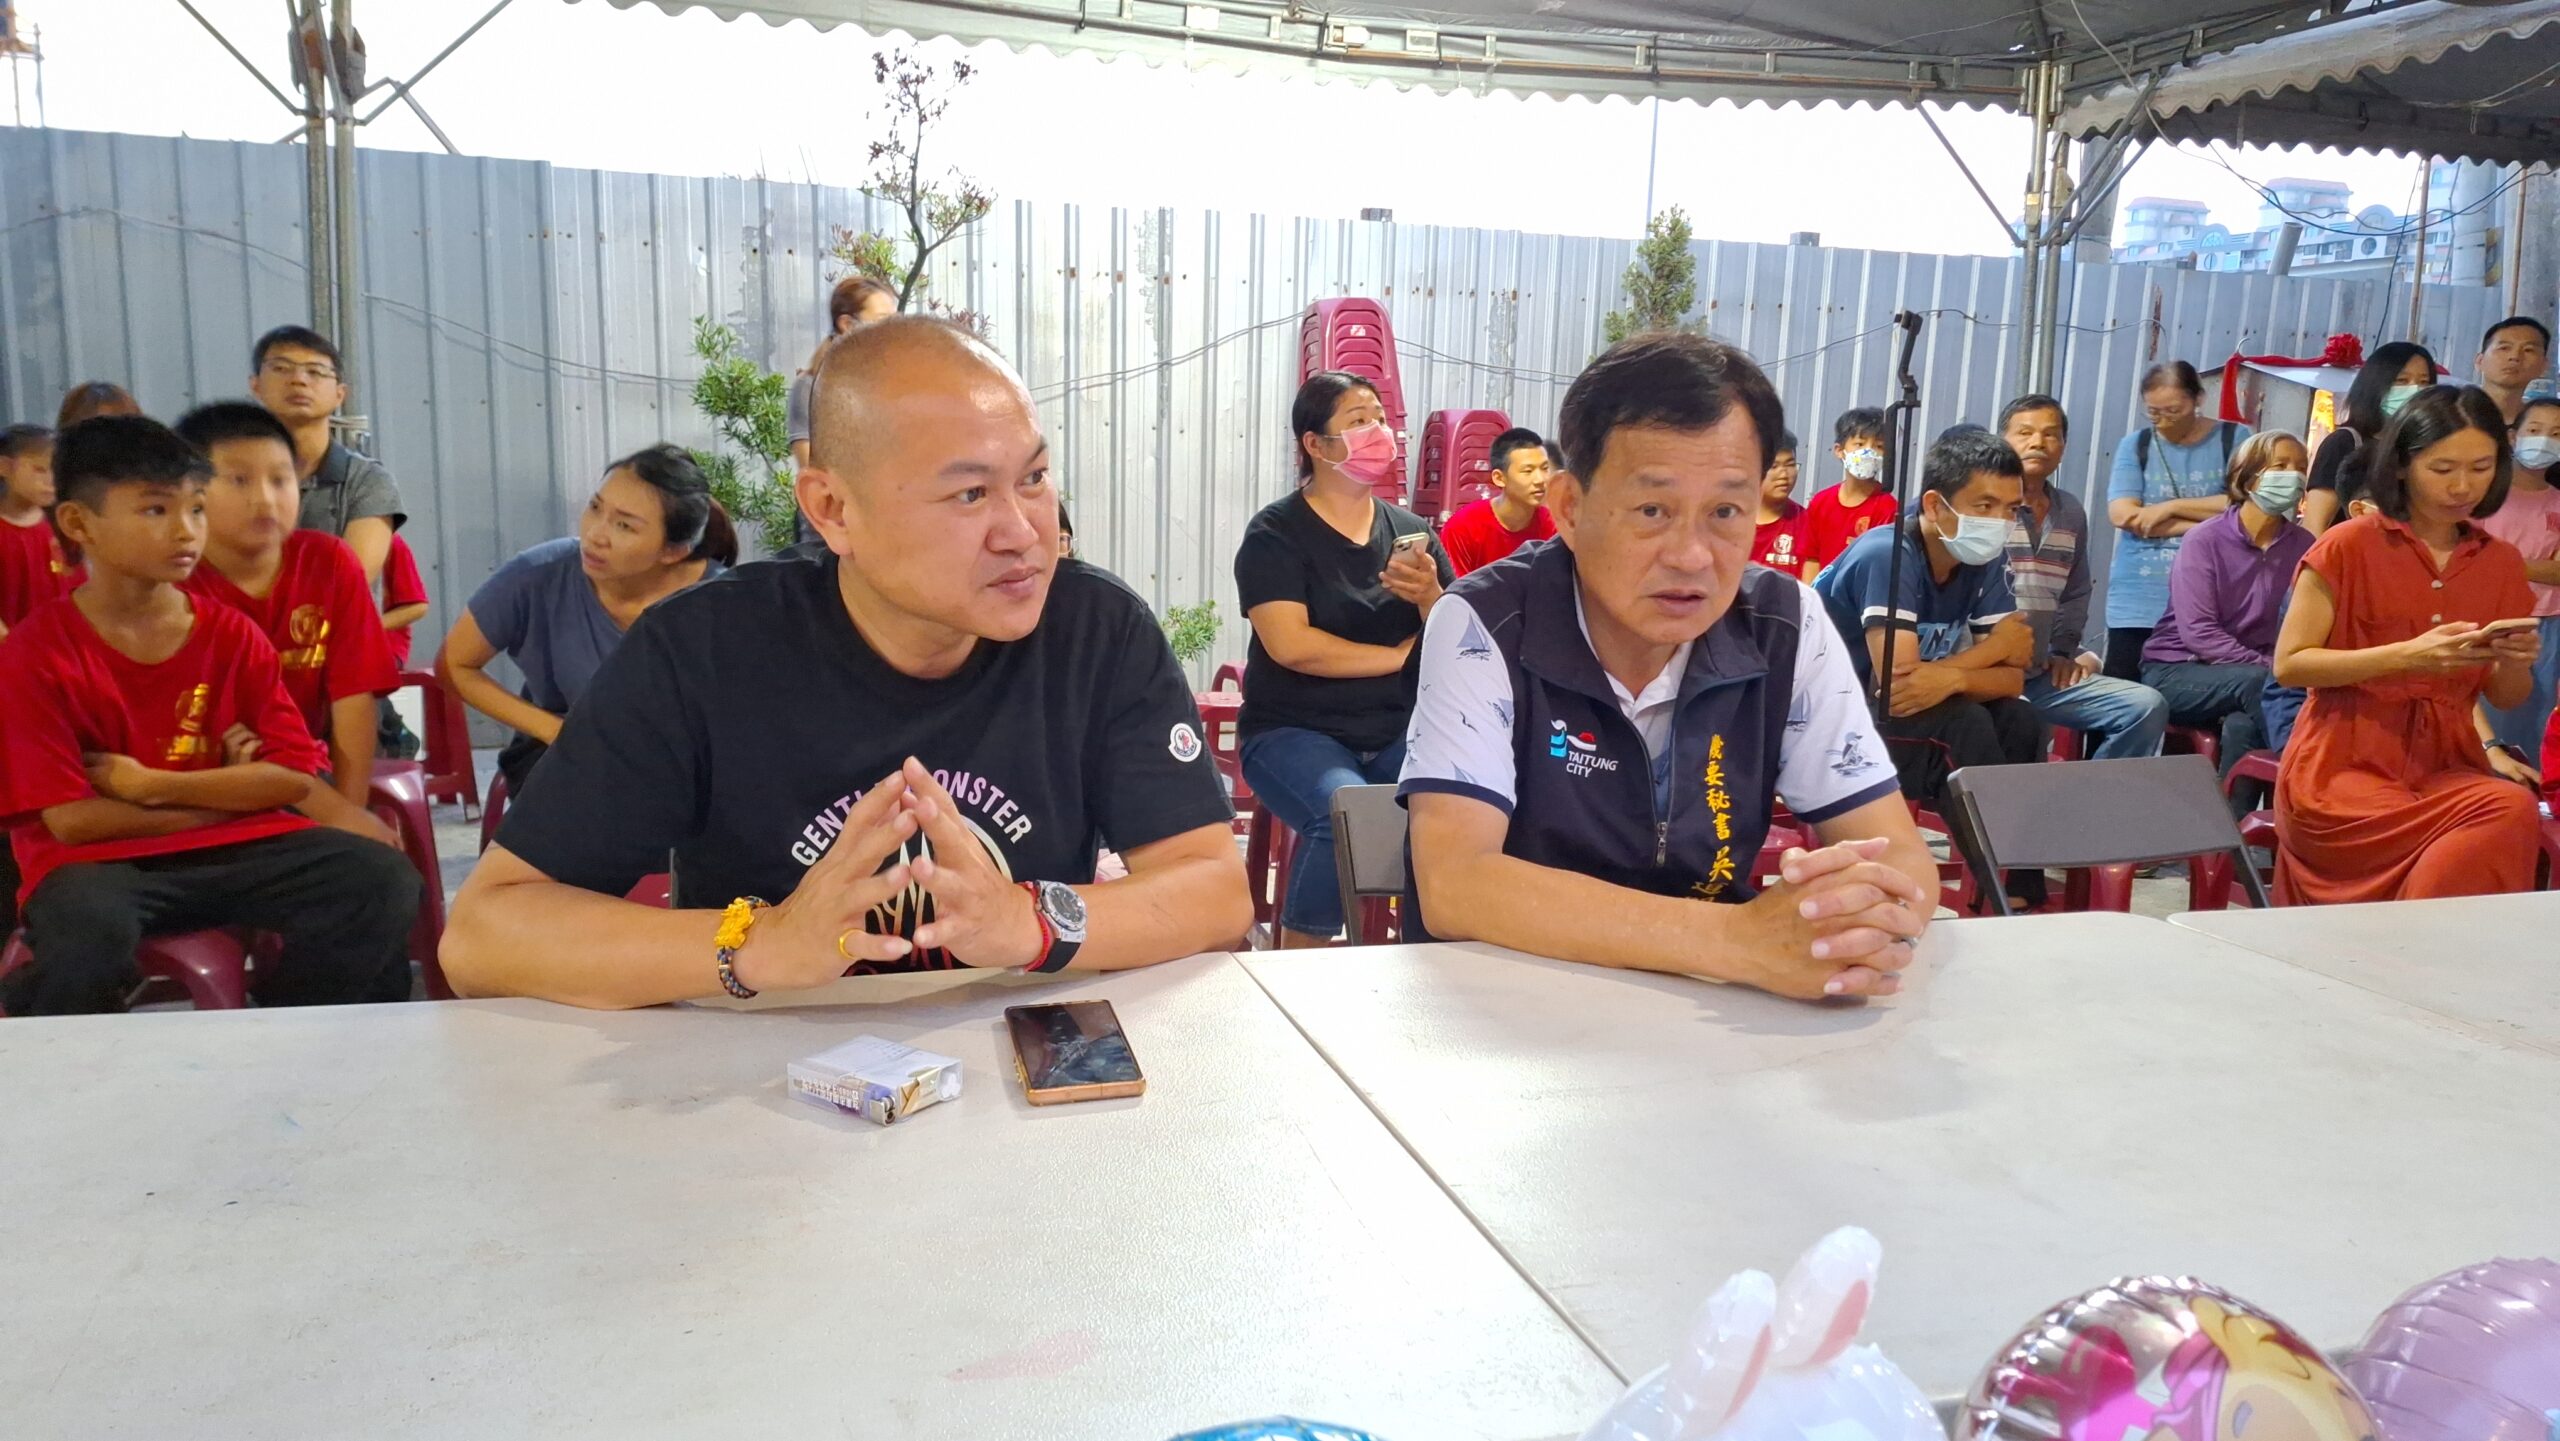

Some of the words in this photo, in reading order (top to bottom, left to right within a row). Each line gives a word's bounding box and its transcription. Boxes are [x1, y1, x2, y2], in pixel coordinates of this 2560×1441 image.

[1566, 762, 1593, 778] CITY
[1568, 750, 1619, 771] TAITUNG
[791, 783, 880, 866] GENT
[912, 769, 1032, 844] ONSTER
